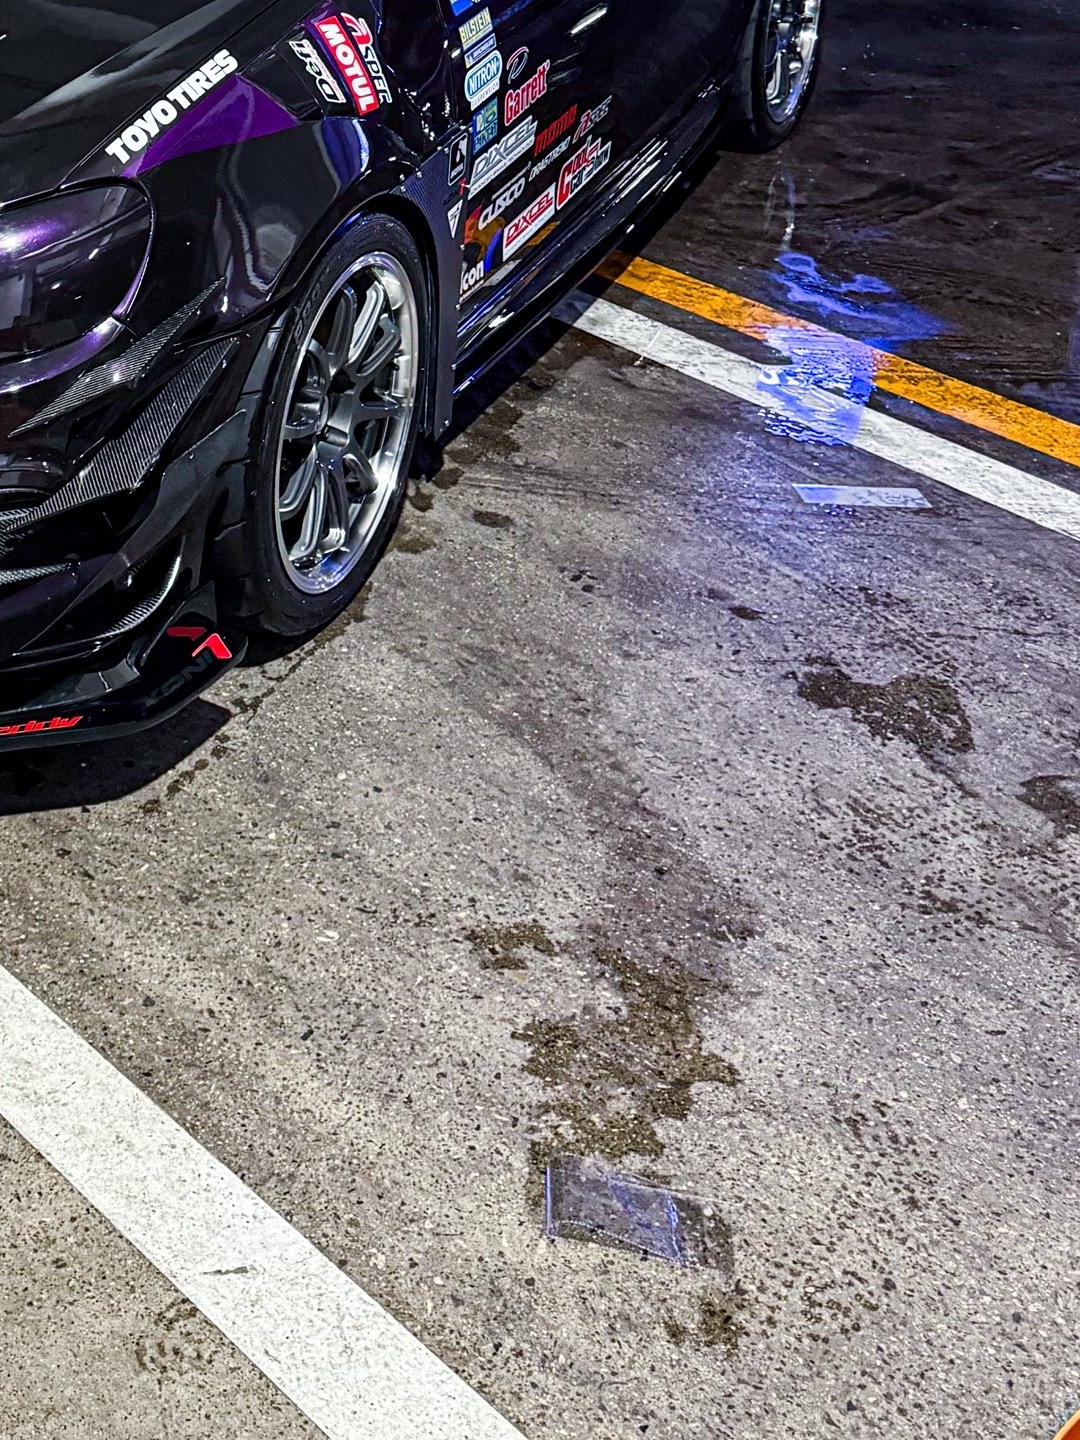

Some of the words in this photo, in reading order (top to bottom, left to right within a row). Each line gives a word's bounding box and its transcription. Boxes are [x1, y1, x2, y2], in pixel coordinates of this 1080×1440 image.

[460, 10, 491, 44] BILSTEIN
[318, 23, 375, 112] MOTUL
[469, 55, 497, 95] NITRON
[504, 64, 548, 126] Garrett
[105, 102, 178, 164] TOYO
[167, 48, 239, 110] TIRES
[473, 118, 533, 178] DIXCEL
[477, 177, 526, 231] CUSCO
[505, 191, 554, 243] DIXCEL
